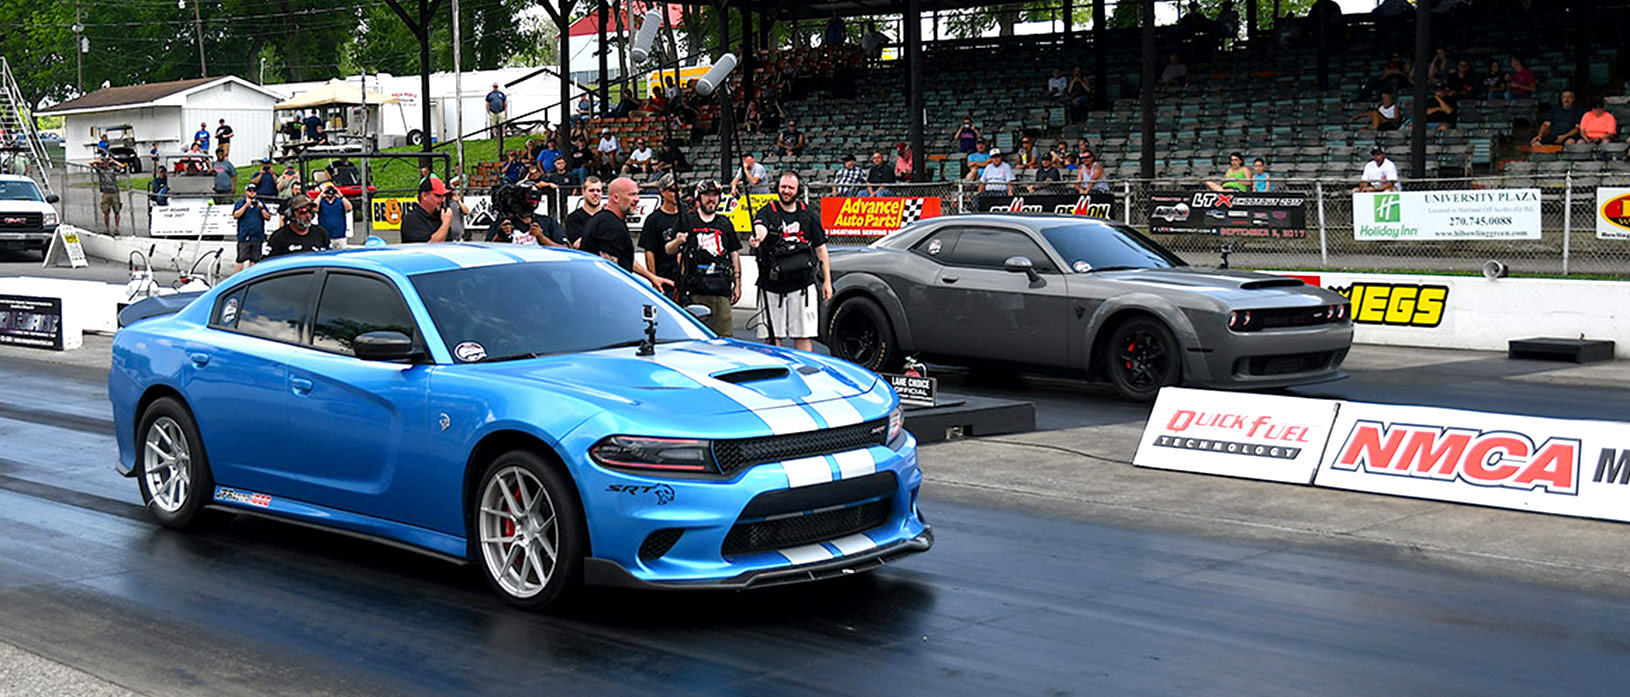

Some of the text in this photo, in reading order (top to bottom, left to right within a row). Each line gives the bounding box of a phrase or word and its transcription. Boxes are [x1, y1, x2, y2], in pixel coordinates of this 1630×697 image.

[1191, 192, 1234, 208] LTX
[1425, 192, 1538, 204] UNIVERSITY PLAZA
[840, 197, 899, 215] Advance
[833, 214, 897, 228] Auto Parts
[1449, 217, 1512, 226] 270.745.0088
[1220, 228, 1269, 236] SEPTEMBER
[1282, 229, 1306, 238] 2017
[1360, 225, 1418, 238] Holiday Inn
[891, 376, 930, 390] LANE CHOICE
[893, 386, 928, 396] OFFICIAL
[1159, 436, 1296, 458] TECHNOLOGY
[1336, 423, 1630, 492] NMCA M
[605, 484, 658, 496] SRT
